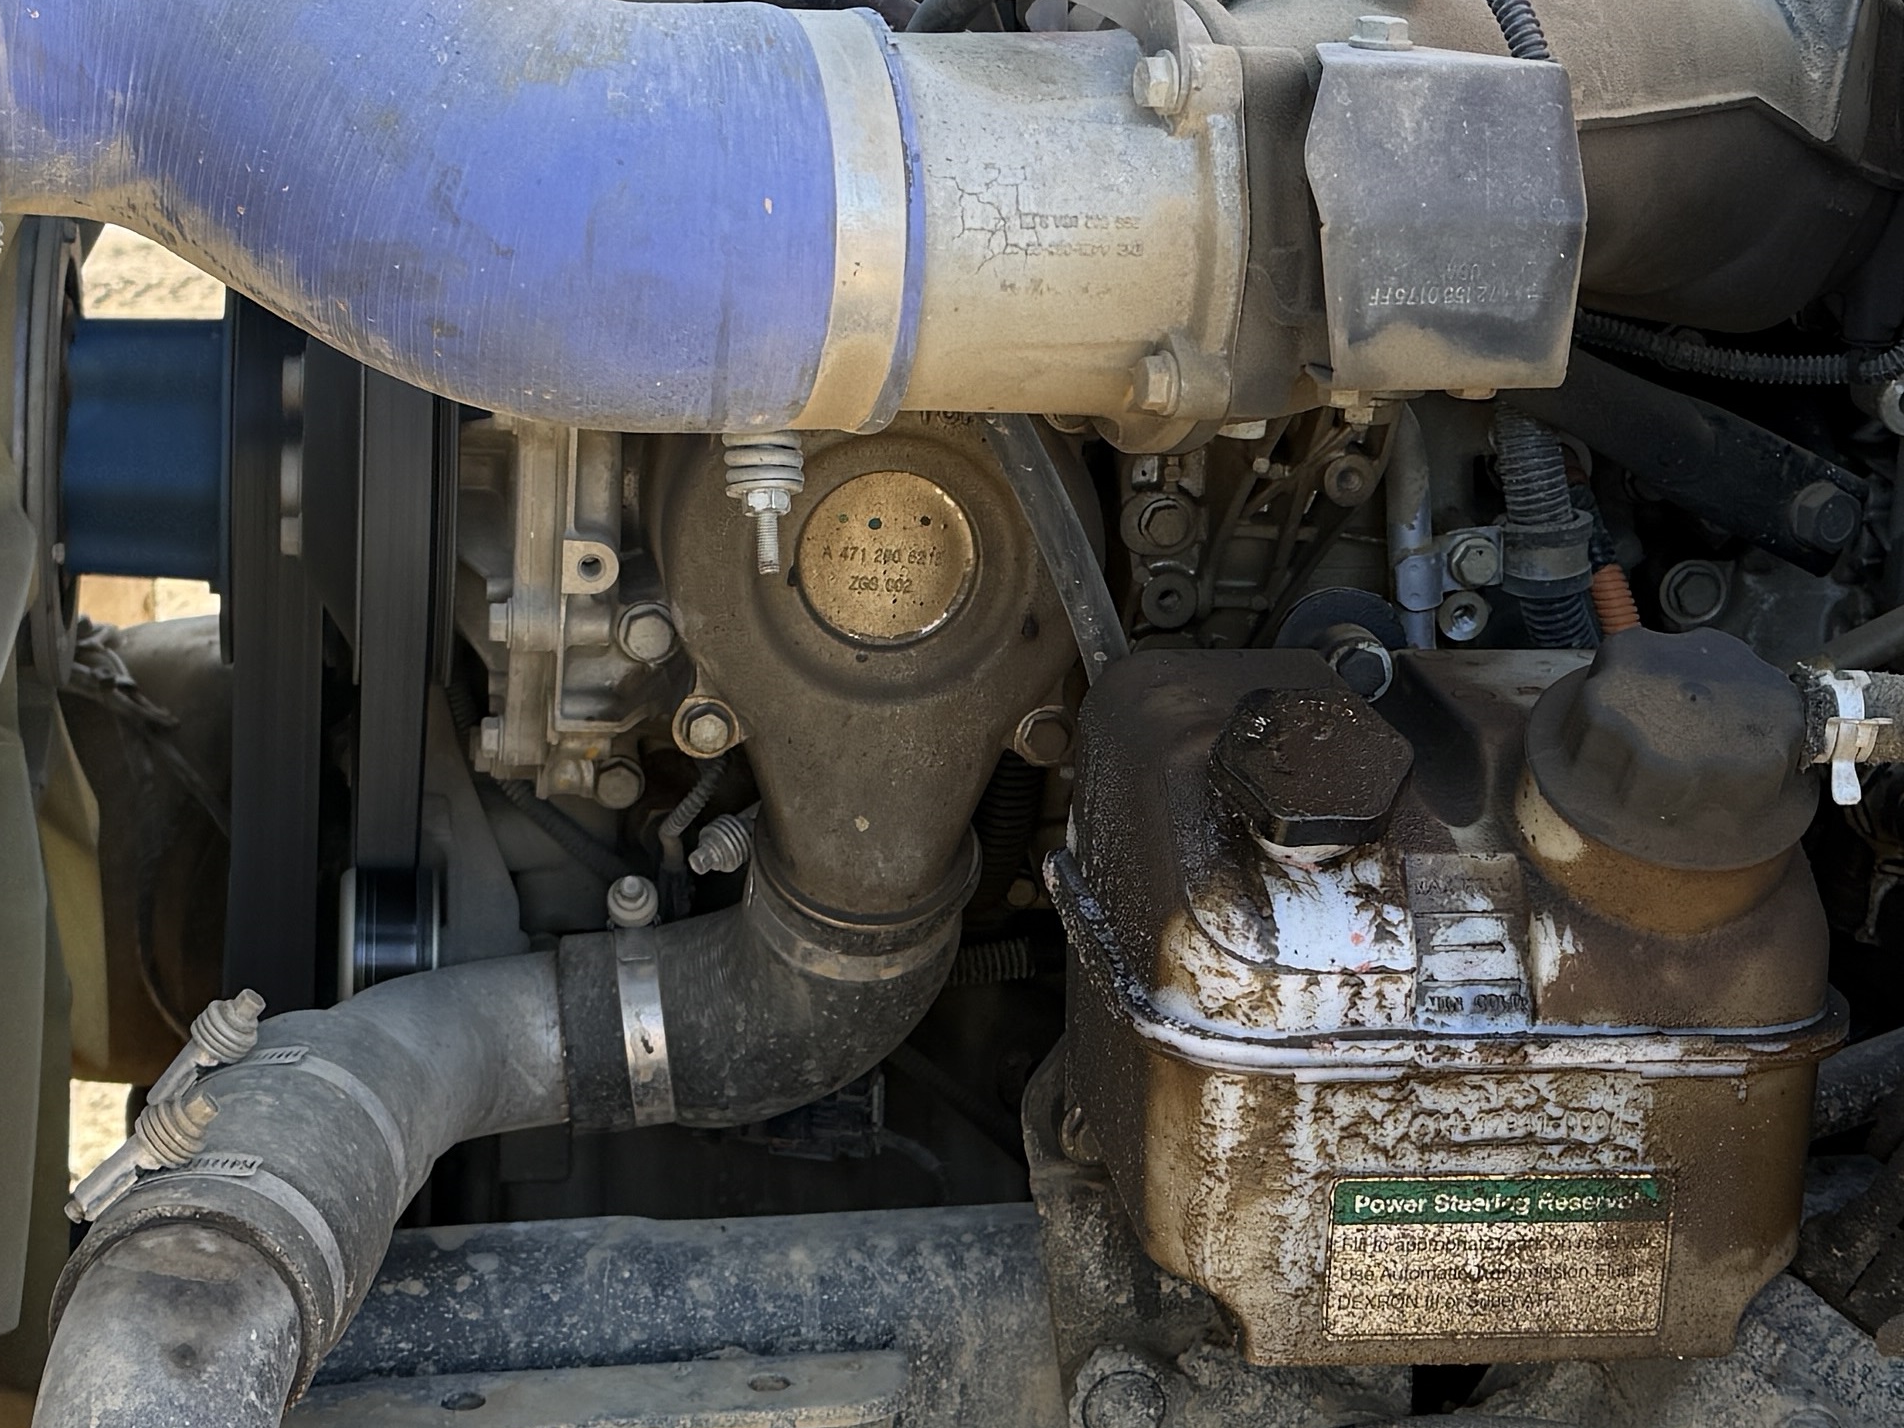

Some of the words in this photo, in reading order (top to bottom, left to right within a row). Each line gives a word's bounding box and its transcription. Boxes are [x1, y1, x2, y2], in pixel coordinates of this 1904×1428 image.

[839, 546, 866, 565] 471
[1354, 1193, 1427, 1215] Power
[1433, 1191, 1530, 1216] Steering
[1340, 1266, 1377, 1281] Use
[1379, 1265, 1467, 1282] Automatic
[1337, 1294, 1419, 1311] DEXRON
